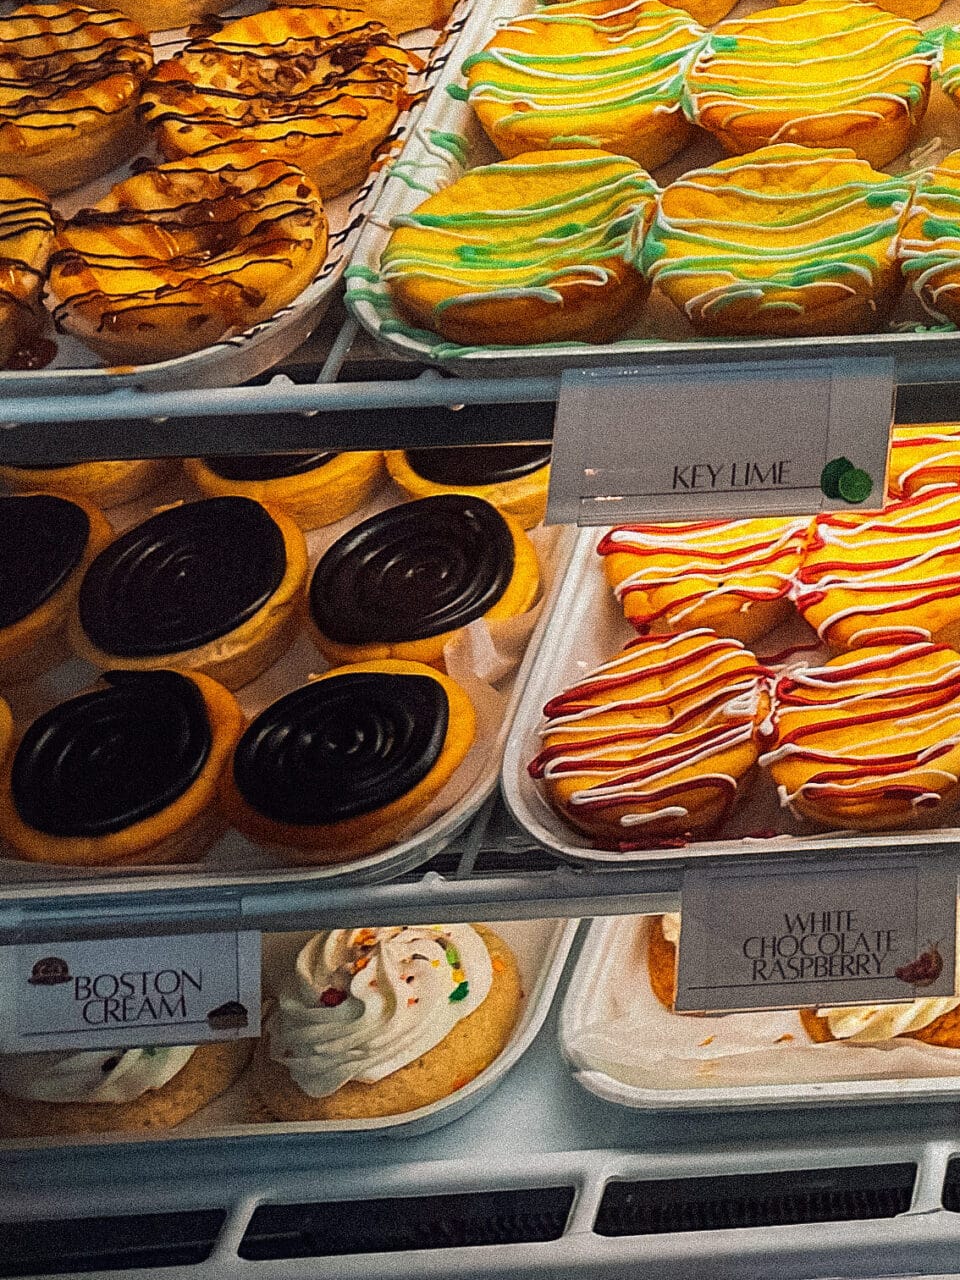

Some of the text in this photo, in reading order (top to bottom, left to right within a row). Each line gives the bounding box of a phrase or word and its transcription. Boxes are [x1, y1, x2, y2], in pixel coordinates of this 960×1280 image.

[672, 461, 791, 490] KEY LIME
[784, 909, 858, 933] WHITE
[743, 929, 899, 960] CHOCOLATE
[752, 953, 886, 981] RASPBERRY
[74, 969, 203, 1001] BOSTON
[82, 994, 188, 1025] CREAM
